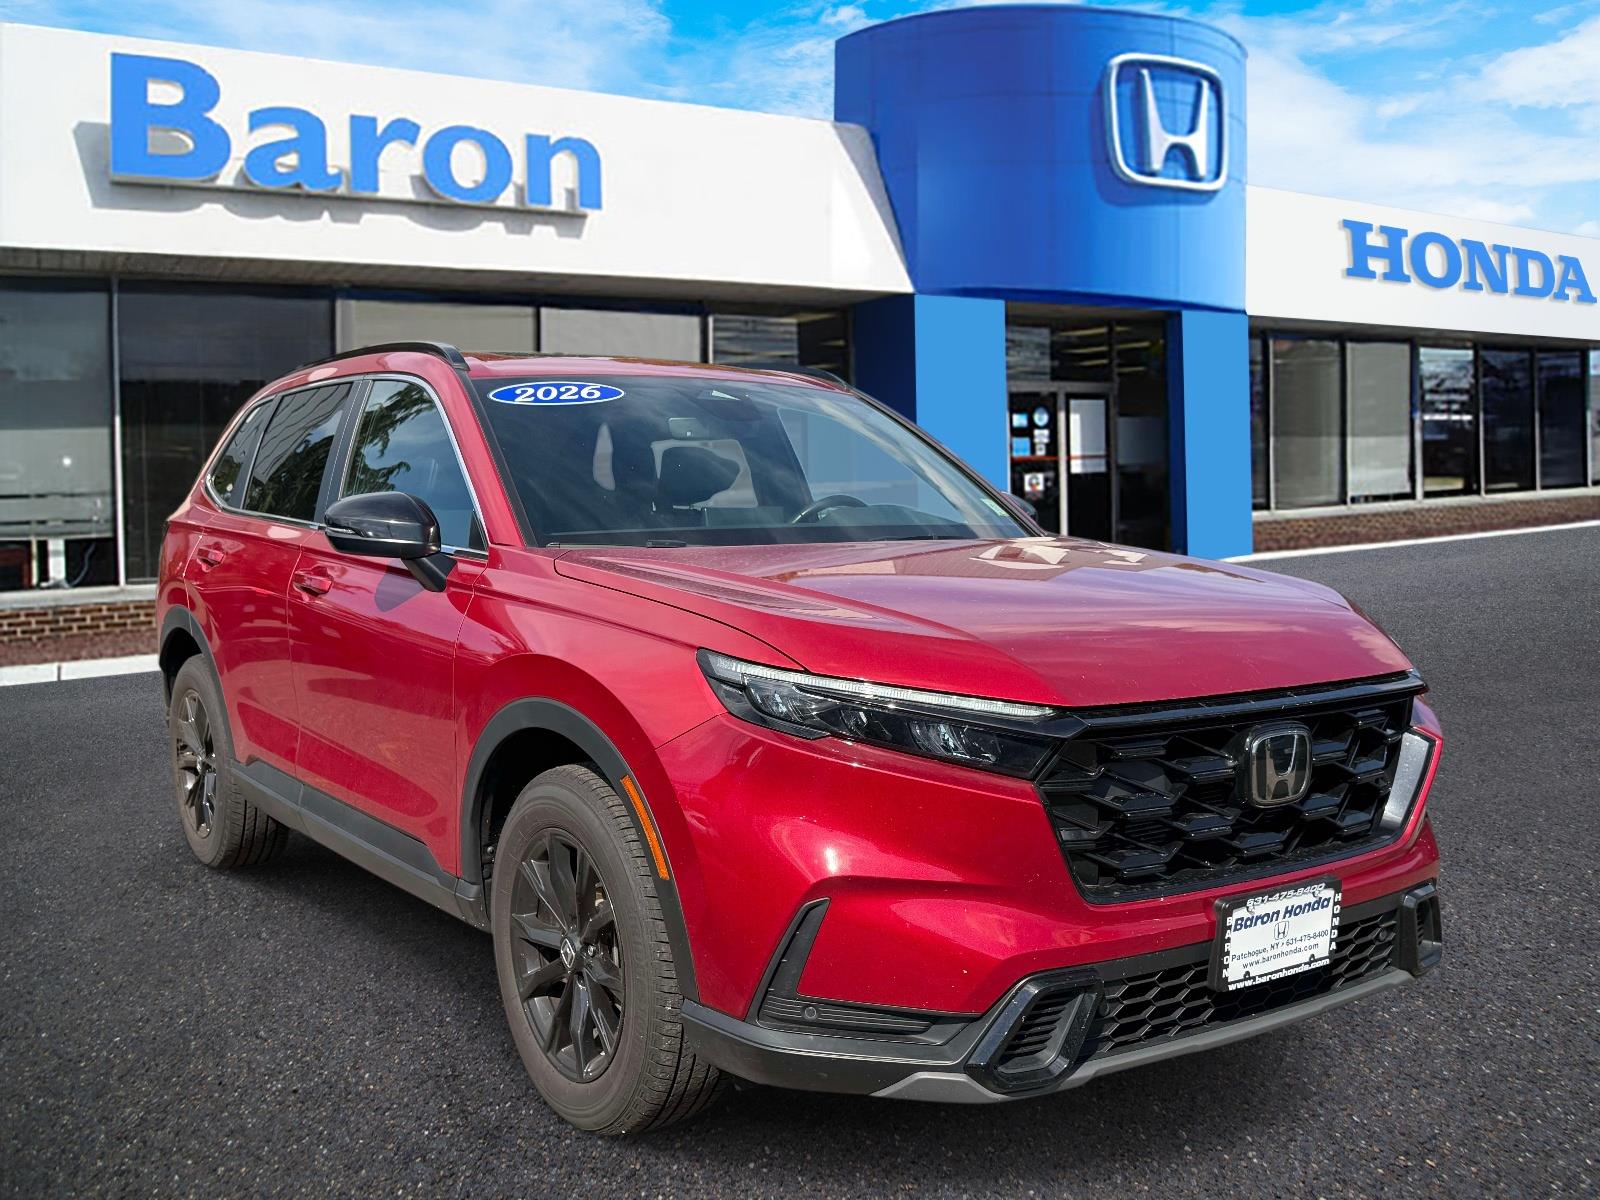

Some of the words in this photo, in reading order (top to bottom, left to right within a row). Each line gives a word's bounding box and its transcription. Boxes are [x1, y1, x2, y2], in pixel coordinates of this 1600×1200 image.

[110, 52, 603, 210] Baron
[1342, 218, 1598, 304] HONDA
[514, 385, 601, 402] 2026
[1233, 909, 1280, 932] Baron
[1282, 896, 1331, 919] Honda
[1231, 947, 1269, 962] Patchogue,
[1270, 942, 1280, 953] NY
[1242, 942, 1319, 969] www.baronhonda.com
[1228, 958, 1330, 991] www.baronhonda.com
